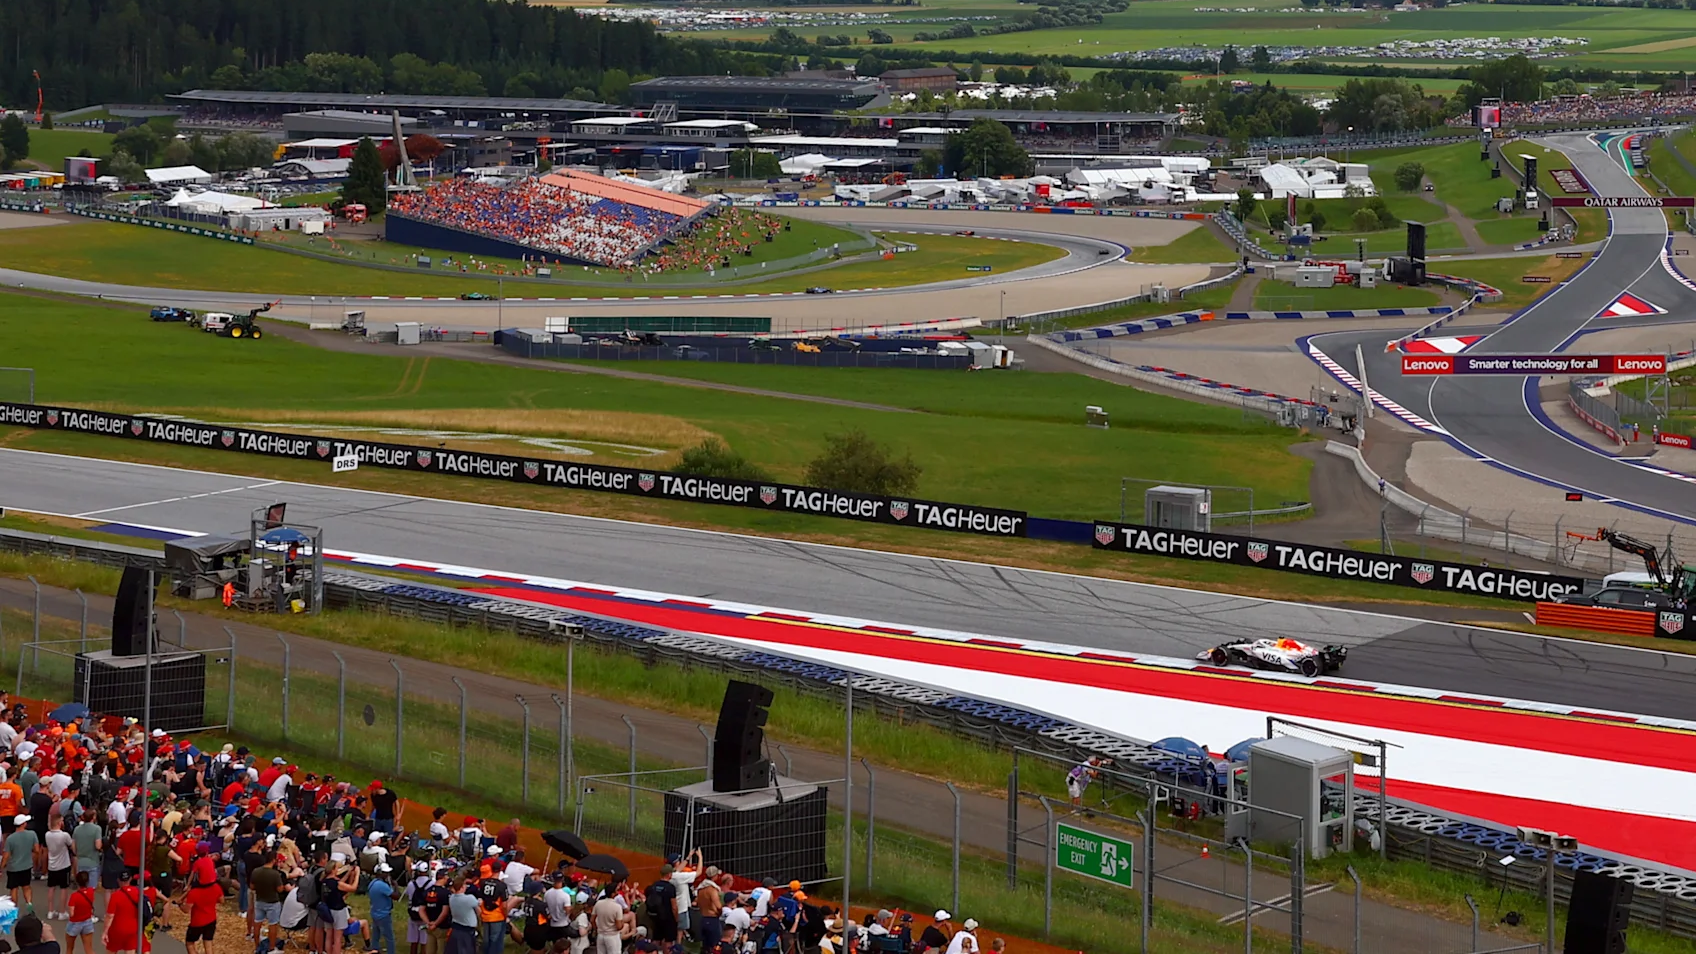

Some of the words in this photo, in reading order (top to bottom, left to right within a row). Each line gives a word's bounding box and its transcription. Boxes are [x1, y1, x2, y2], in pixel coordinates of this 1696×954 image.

[1584, 198, 1618, 208] QATAR
[1620, 197, 1663, 207] AIRWAYS
[1404, 359, 1449, 370] Lenovo
[1469, 359, 1510, 369] Smarter
[1512, 359, 1568, 371] technology
[1570, 359, 1585, 369] for
[1586, 359, 1598, 369] all
[1617, 359, 1662, 369] Lenovo
[62, 412, 128, 434] TAGHeuer
[147, 421, 217, 445] TAGHeuer
[238, 432, 312, 456] TAGHeuer
[1661, 435, 1688, 445] Lenovo
[336, 458, 355, 469] DRS
[435, 452, 518, 477] TAGHeuer
[544, 463, 632, 489] TAGHeuer
[660, 475, 753, 502] TAGHeuer
[781, 488, 883, 517] TAGHeuer
[892, 501, 908, 510] TAG
[914, 504, 1022, 534] TAGHeuer
[1096, 526, 1115, 534] TAG
[1121, 528, 1239, 559] TAGHeuer
[1249, 543, 1268, 551] TAG
[1275, 545, 1402, 580] TAGHeuer
[1413, 564, 1433, 573] TAG
[1662, 612, 1682, 621] TAG
[1660, 621, 1682, 632] HEUER
[1262, 652, 1282, 664] VISA
[1060, 833, 1098, 853] EMERGENCY
[1071, 851, 1086, 865] EXIT
[484, 885, 495, 896] 81
